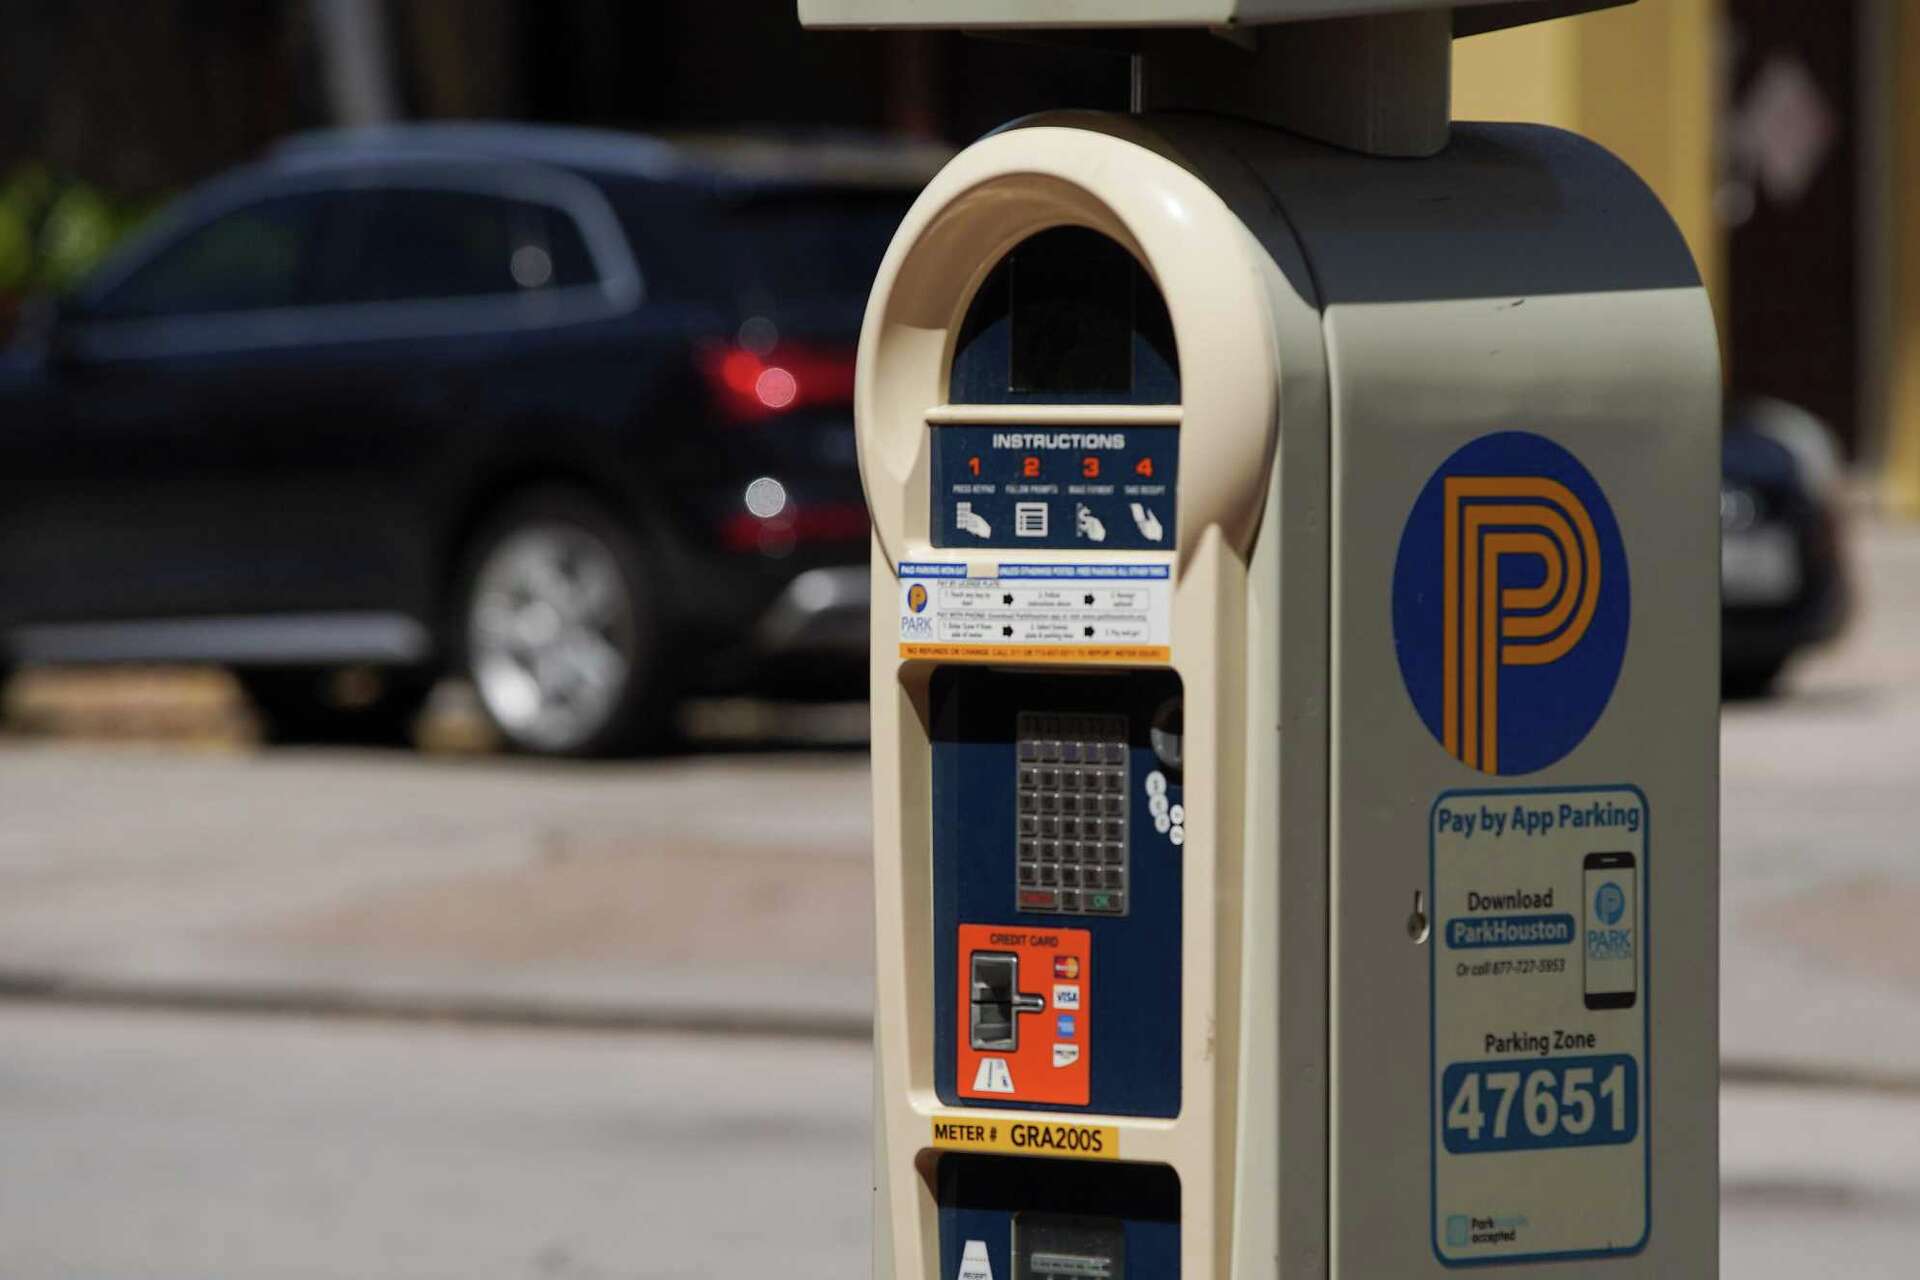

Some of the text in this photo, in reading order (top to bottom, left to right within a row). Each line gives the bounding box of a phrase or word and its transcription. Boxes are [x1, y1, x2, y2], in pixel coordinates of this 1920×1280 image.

[992, 433, 1126, 449] INSTRUCTIONS
[969, 457, 1152, 478] 1 2 3 4
[901, 616, 933, 633] PARK
[1443, 476, 1602, 776] P
[1438, 802, 1640, 838] Pay by App Parking
[1467, 887, 1553, 912] Download
[989, 933, 1059, 948] CREDIT CARD
[1453, 917, 1568, 946] ParkHouston
[1455, 962, 1468, 977] Or
[1471, 960, 1490, 976] call
[1057, 991, 1078, 1003] VISA
[1485, 1030, 1596, 1056] Parking Zone
[1448, 1064, 1626, 1140] 47651
[935, 1124, 1103, 1152] METER # GRA200S
